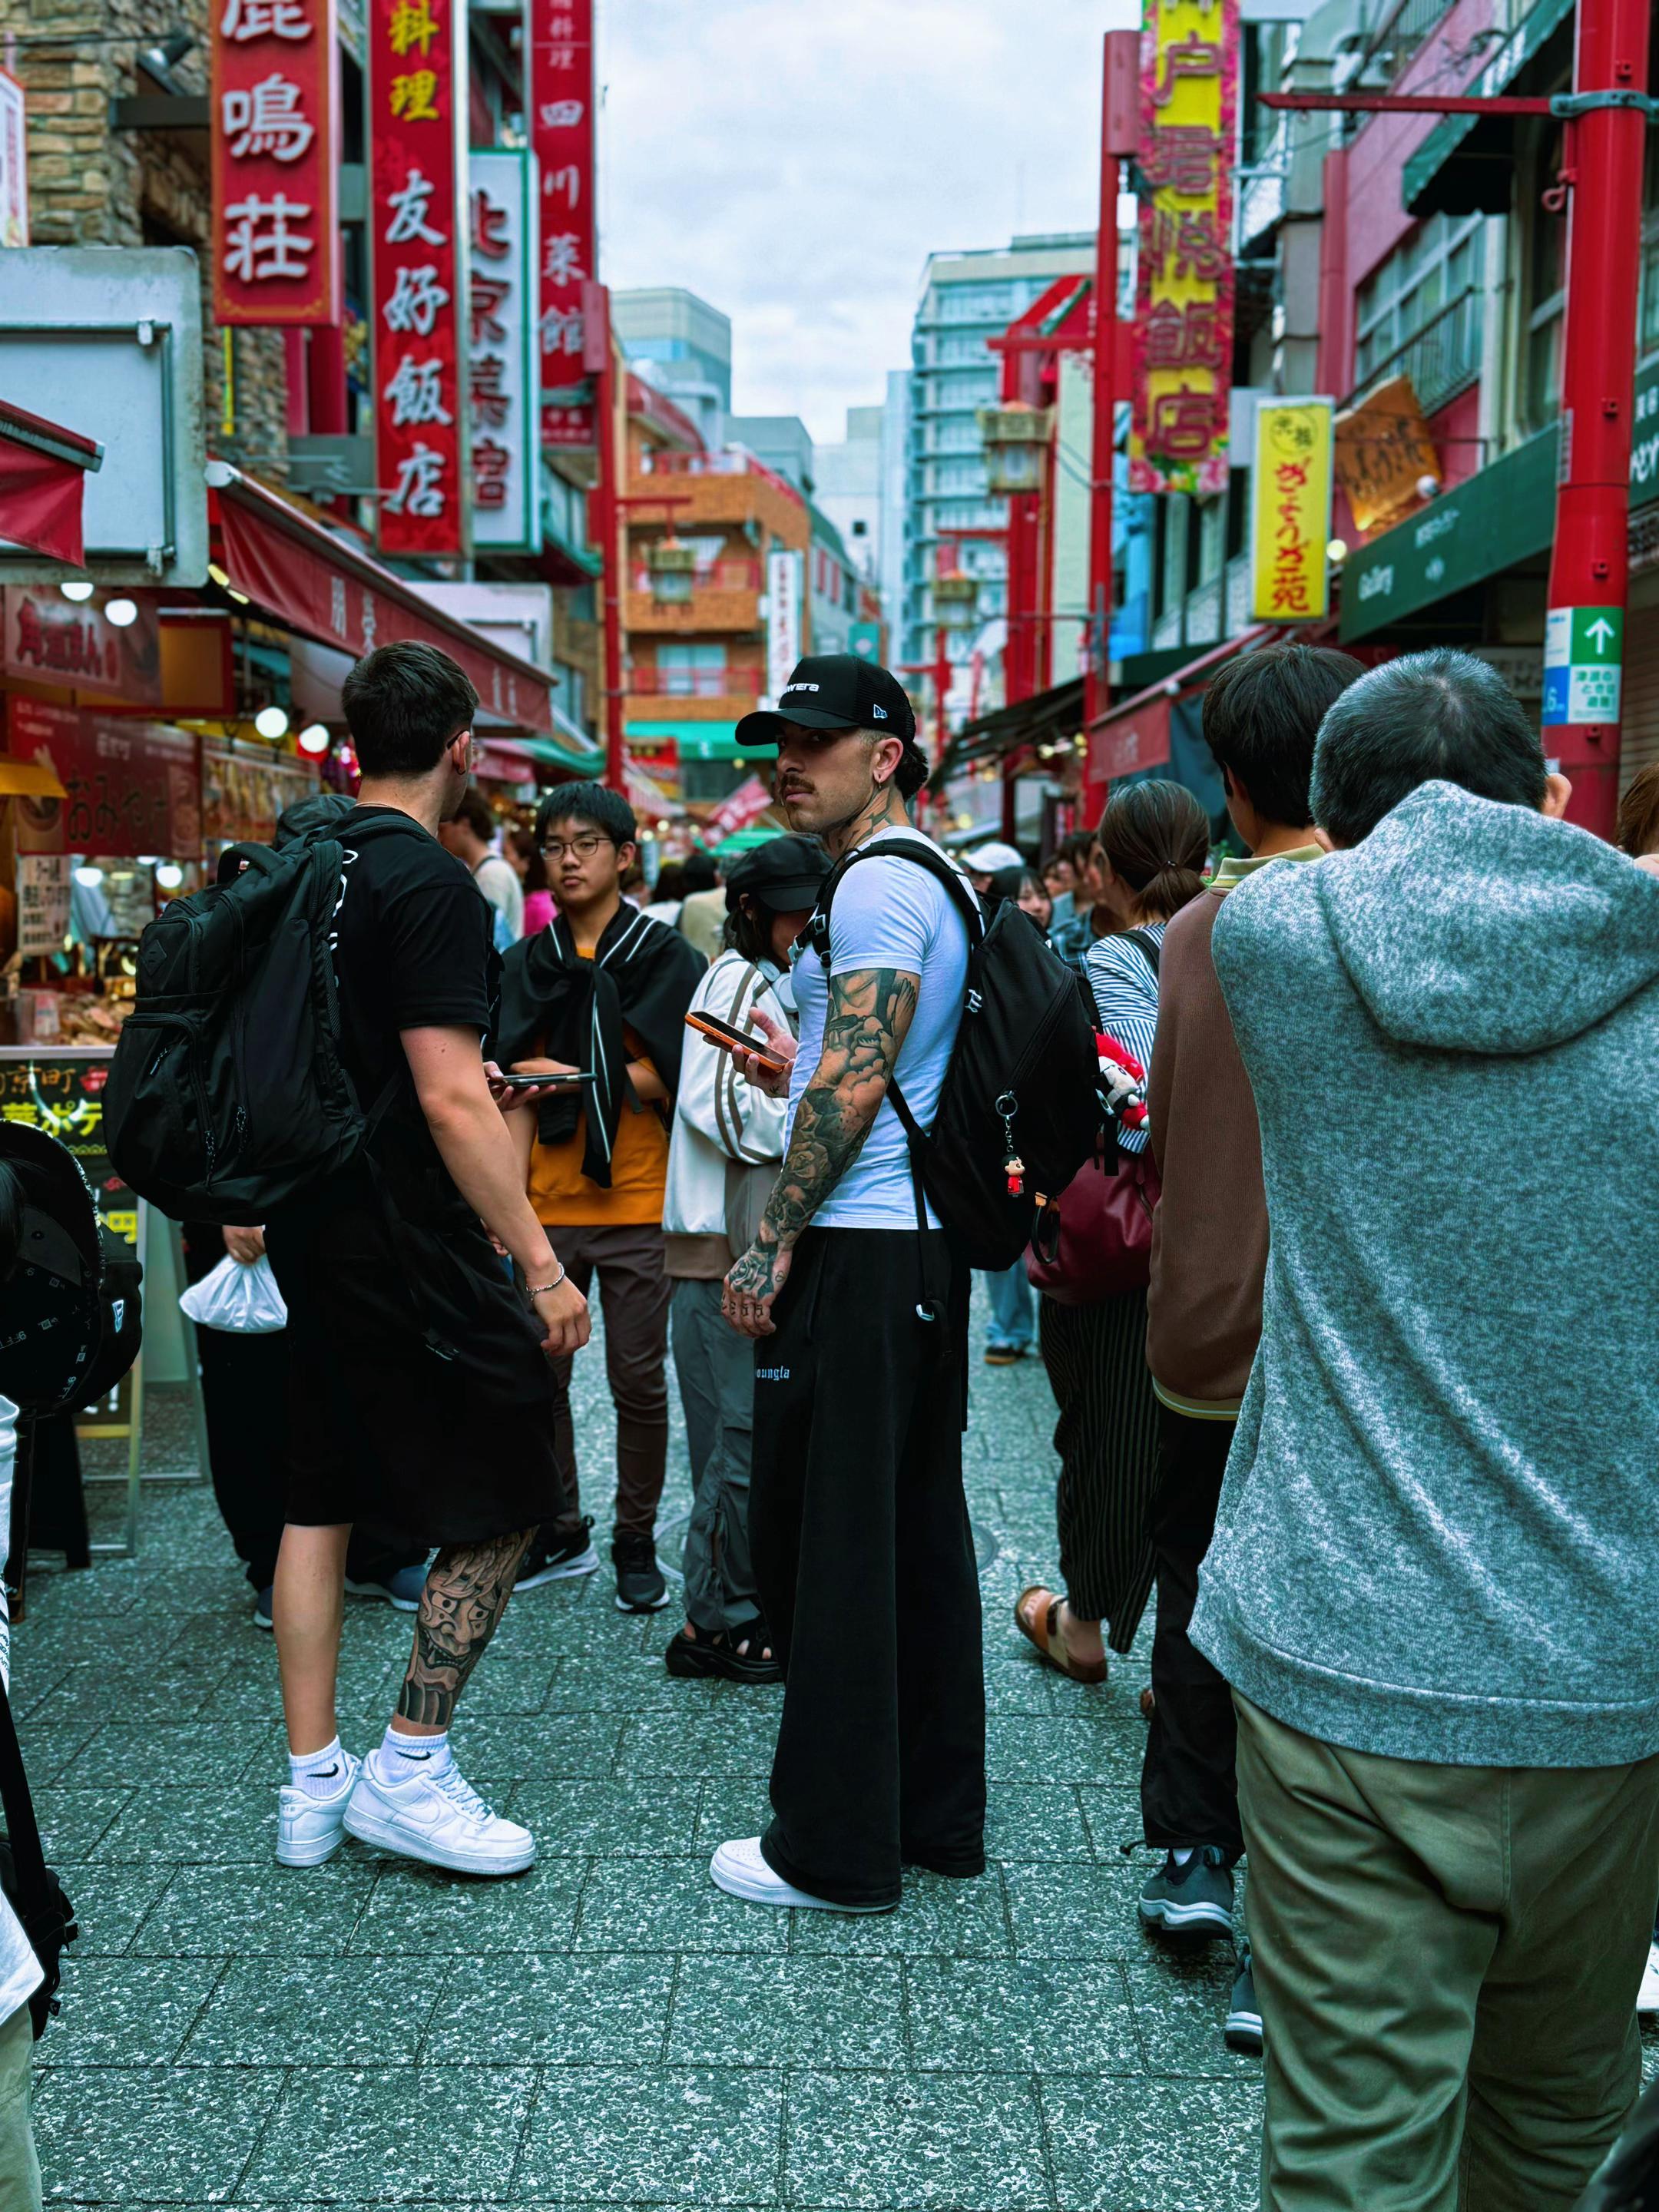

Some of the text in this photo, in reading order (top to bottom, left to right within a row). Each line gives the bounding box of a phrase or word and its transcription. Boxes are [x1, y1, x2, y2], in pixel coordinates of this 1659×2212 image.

[387, 0, 440, 122] 料理
[382, 168, 454, 516] 友好飯店
[0, 1065, 76, 1094] 京町
[757, 1366, 790, 1381] oungla
